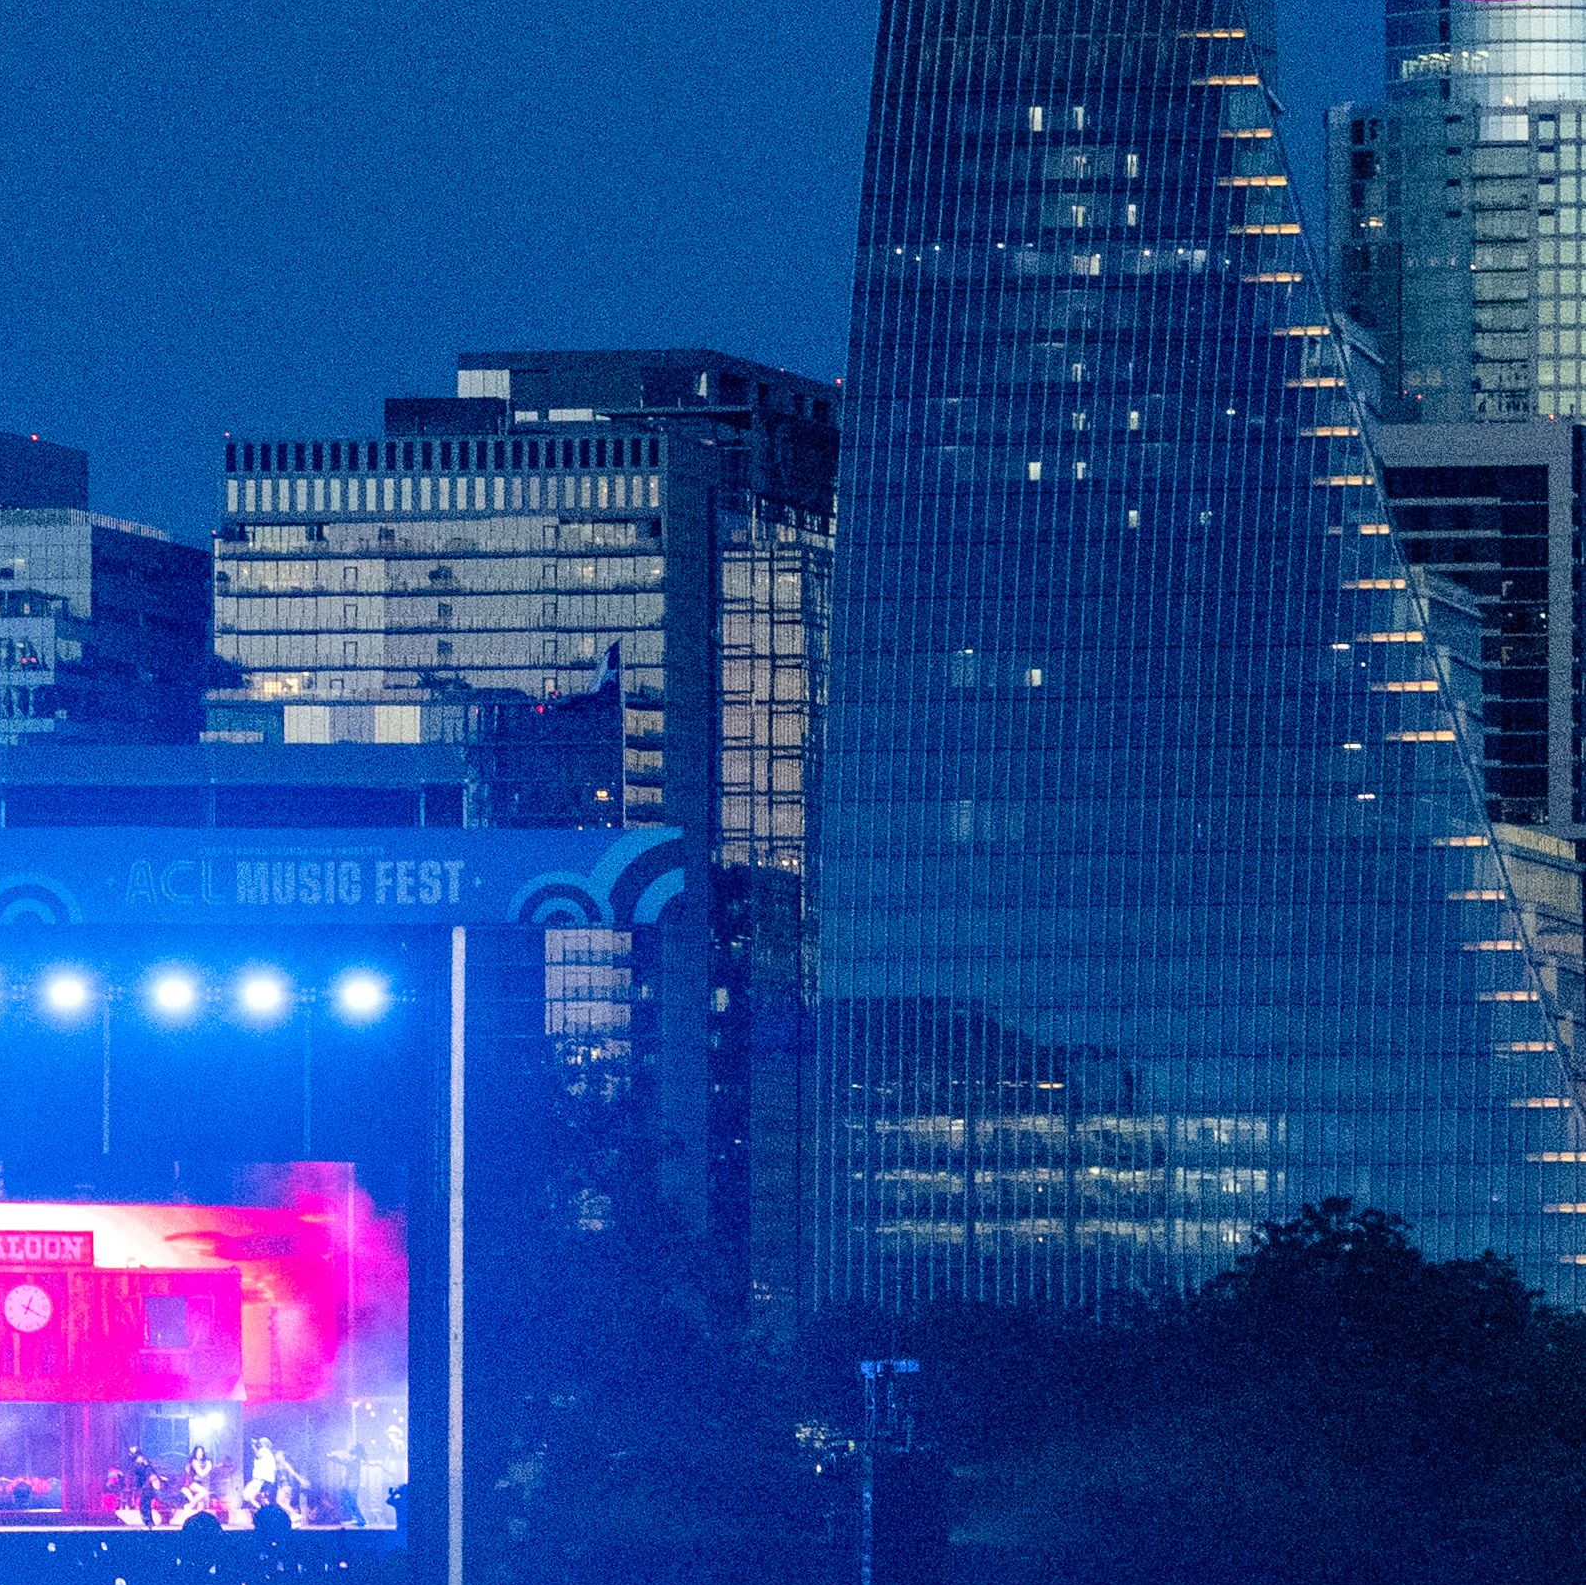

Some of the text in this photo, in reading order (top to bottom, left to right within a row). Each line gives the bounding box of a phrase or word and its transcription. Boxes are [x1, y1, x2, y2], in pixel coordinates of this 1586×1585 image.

[130, 859, 466, 905] ACL MUSIC FEST
